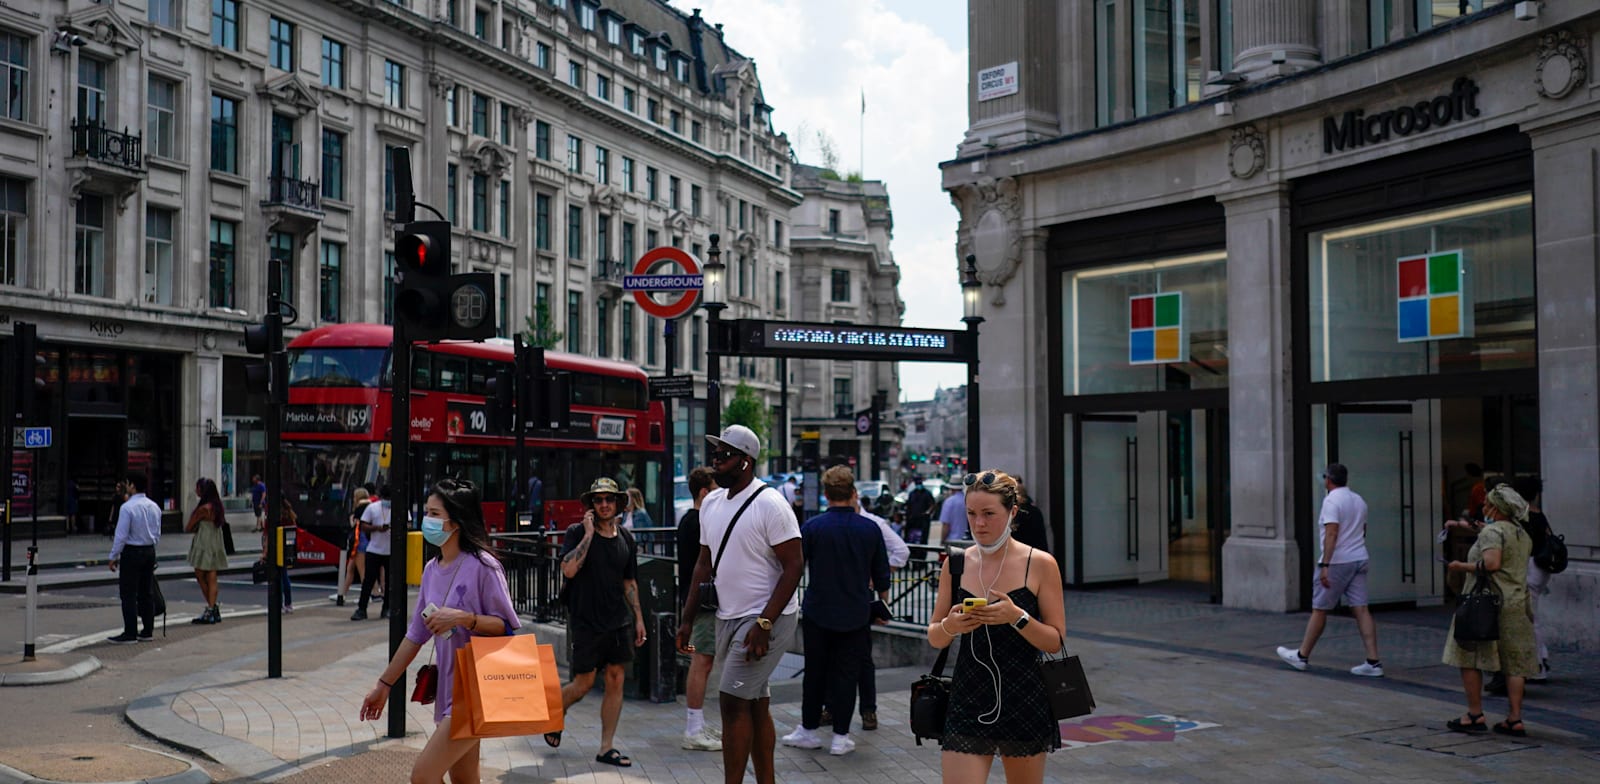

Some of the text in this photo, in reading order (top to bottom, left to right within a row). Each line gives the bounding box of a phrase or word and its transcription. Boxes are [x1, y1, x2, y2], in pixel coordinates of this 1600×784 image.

[981, 68, 1005, 81] OXFORD
[981, 78, 1004, 90] CIRCUS
[1323, 75, 1481, 154] Microsoft
[626, 276, 703, 288] UNDERGROUND
[89, 319, 124, 335] KIKO
[774, 328, 945, 348] OXFORD CIRCUS STATION
[285, 411, 336, 423] Marble Arch
[347, 408, 367, 427] 159
[600, 421, 623, 436] GORILLAS
[483, 673, 537, 681] LOUIS VUITTON
